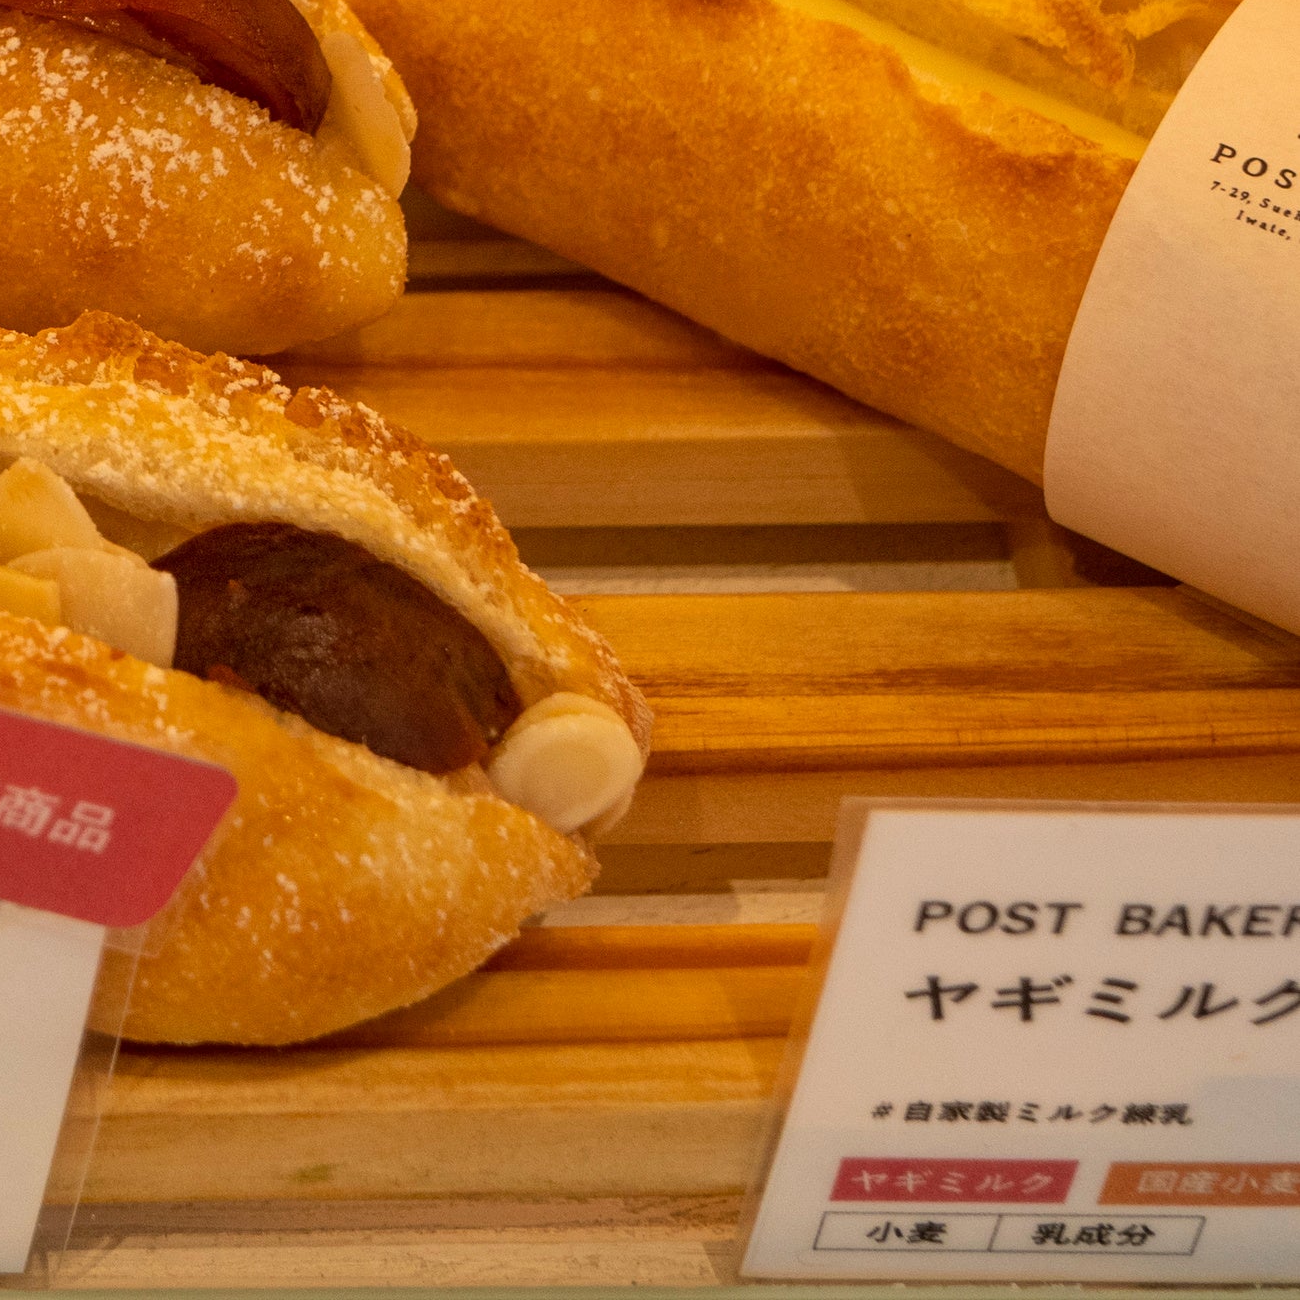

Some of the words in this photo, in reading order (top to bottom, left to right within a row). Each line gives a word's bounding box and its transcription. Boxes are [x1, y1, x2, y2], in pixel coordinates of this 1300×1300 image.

[1210, 181, 1252, 204] 7-29,
[1236, 210, 1291, 240] Iwate,
[913, 900, 1084, 935] POST
[851, 1168, 1054, 1194] ヤギミルク
[866, 1222, 947, 1245] 小麦
[1032, 1223, 1155, 1247] 乳成分
